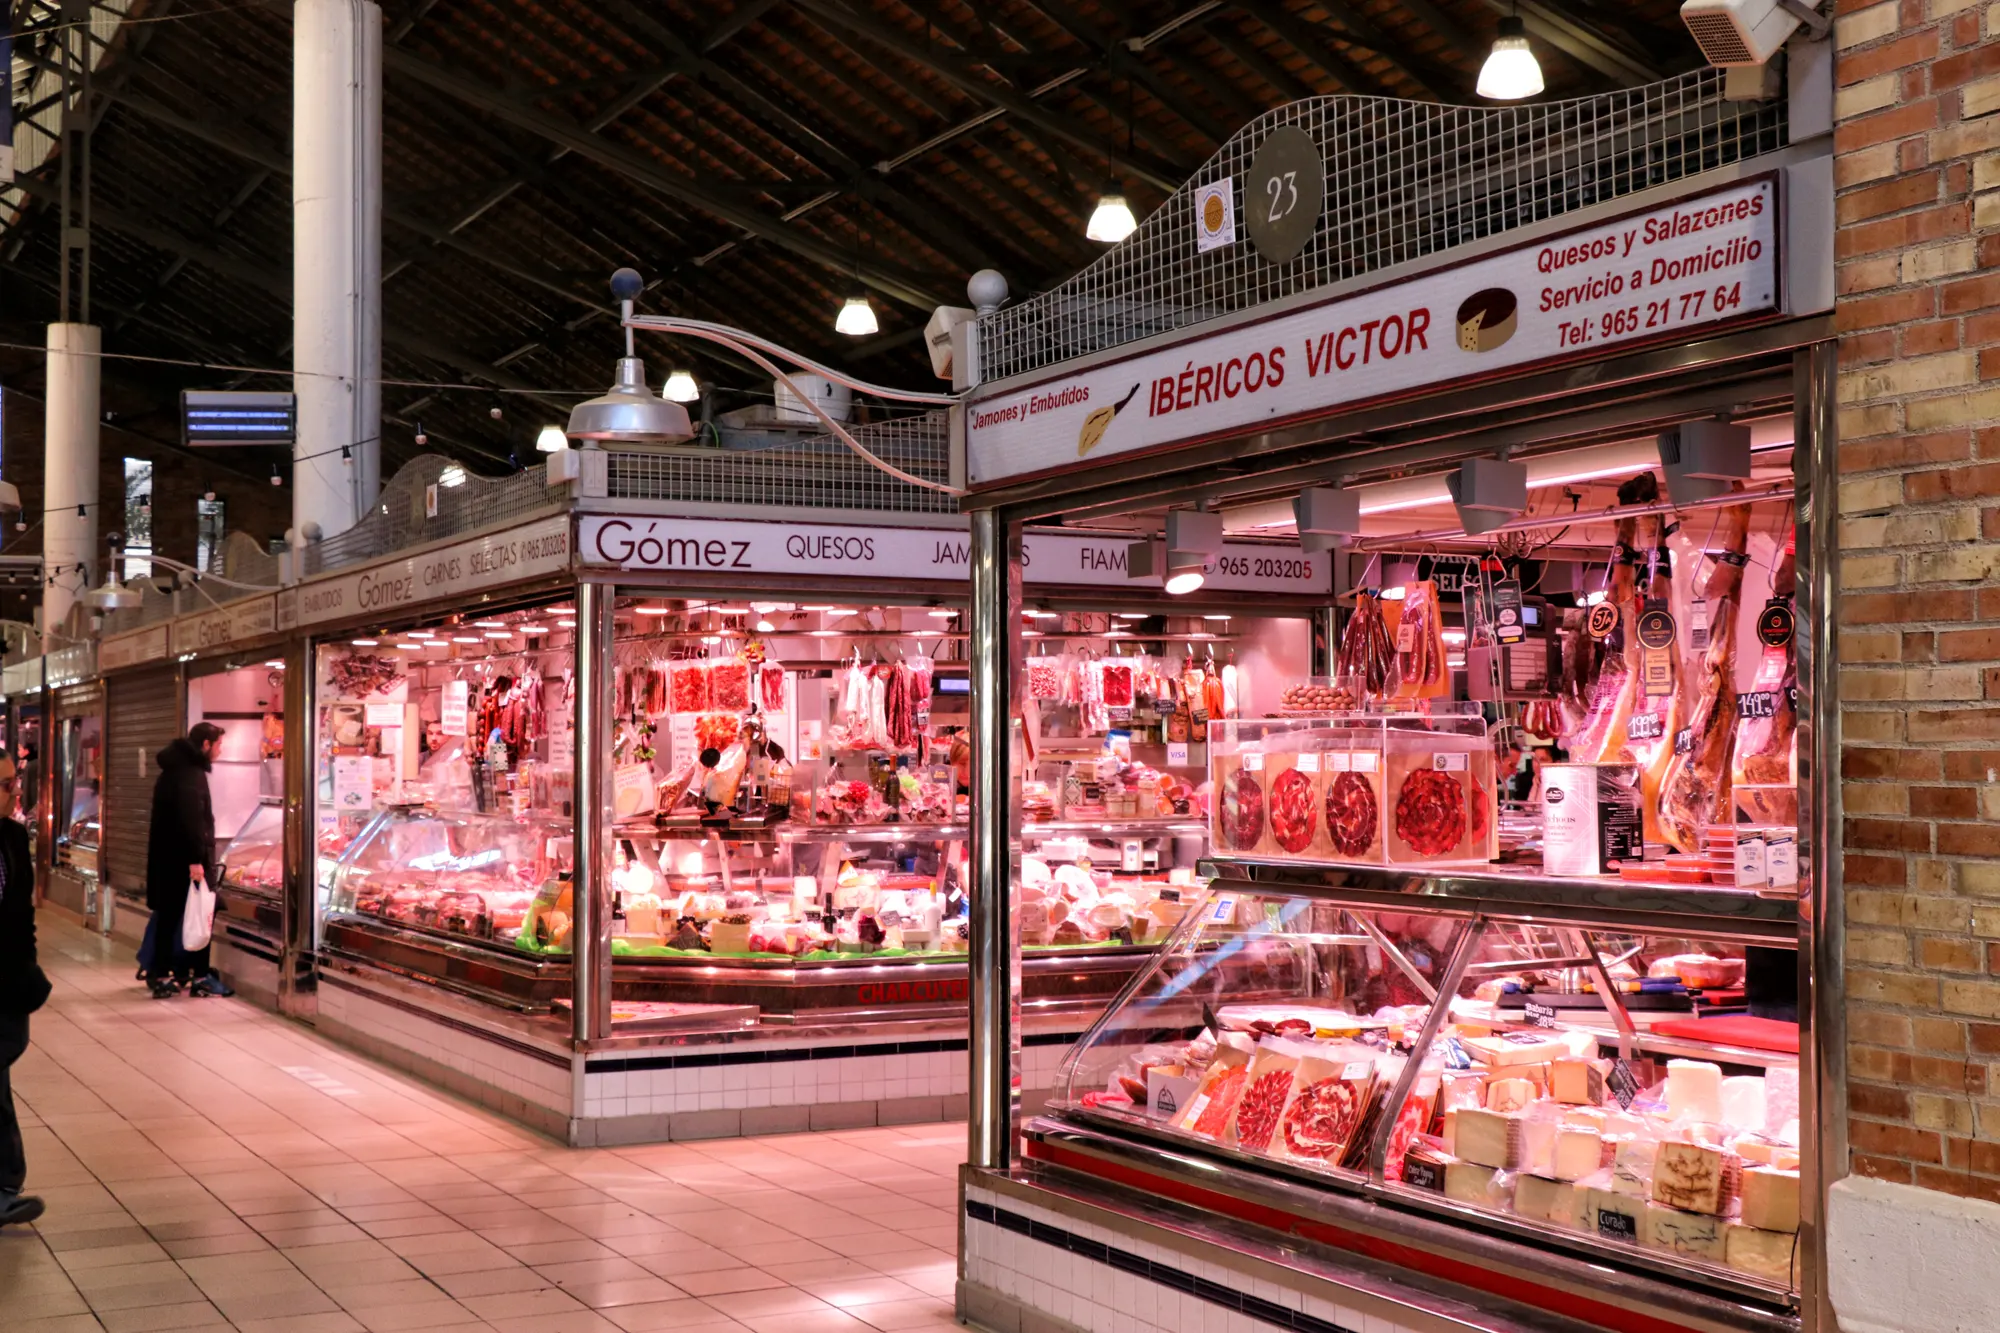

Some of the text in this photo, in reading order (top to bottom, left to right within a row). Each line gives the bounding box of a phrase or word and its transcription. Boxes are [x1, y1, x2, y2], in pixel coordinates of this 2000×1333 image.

[1266, 171, 1298, 223] 23
[1537, 194, 1764, 274] Quesos y Salazones
[1539, 236, 1762, 312] Servicio a Domicilio
[1558, 282, 1741, 348] Tel: 965 21 77 64
[1149, 307, 1431, 418] IBÉRICOS VICTOR
[972, 385, 1089, 430] Jamones y Embutidos
[595, 519, 752, 568] Gómez
[786, 534, 875, 561] QUESOS
[1219, 555, 1313, 580] 965 203205
[304, 588, 343, 614] EMBUTIDOS
[358, 572, 413, 609] Gómez
[423, 557, 461, 586] CARNES
[469, 541, 517, 575] SELECTAS
[527, 540, 540, 561] 965
[540, 532, 566, 559] 203205
[1170, 751, 1186, 759] VISA
[1600, 1211, 1627, 1230] Curado
